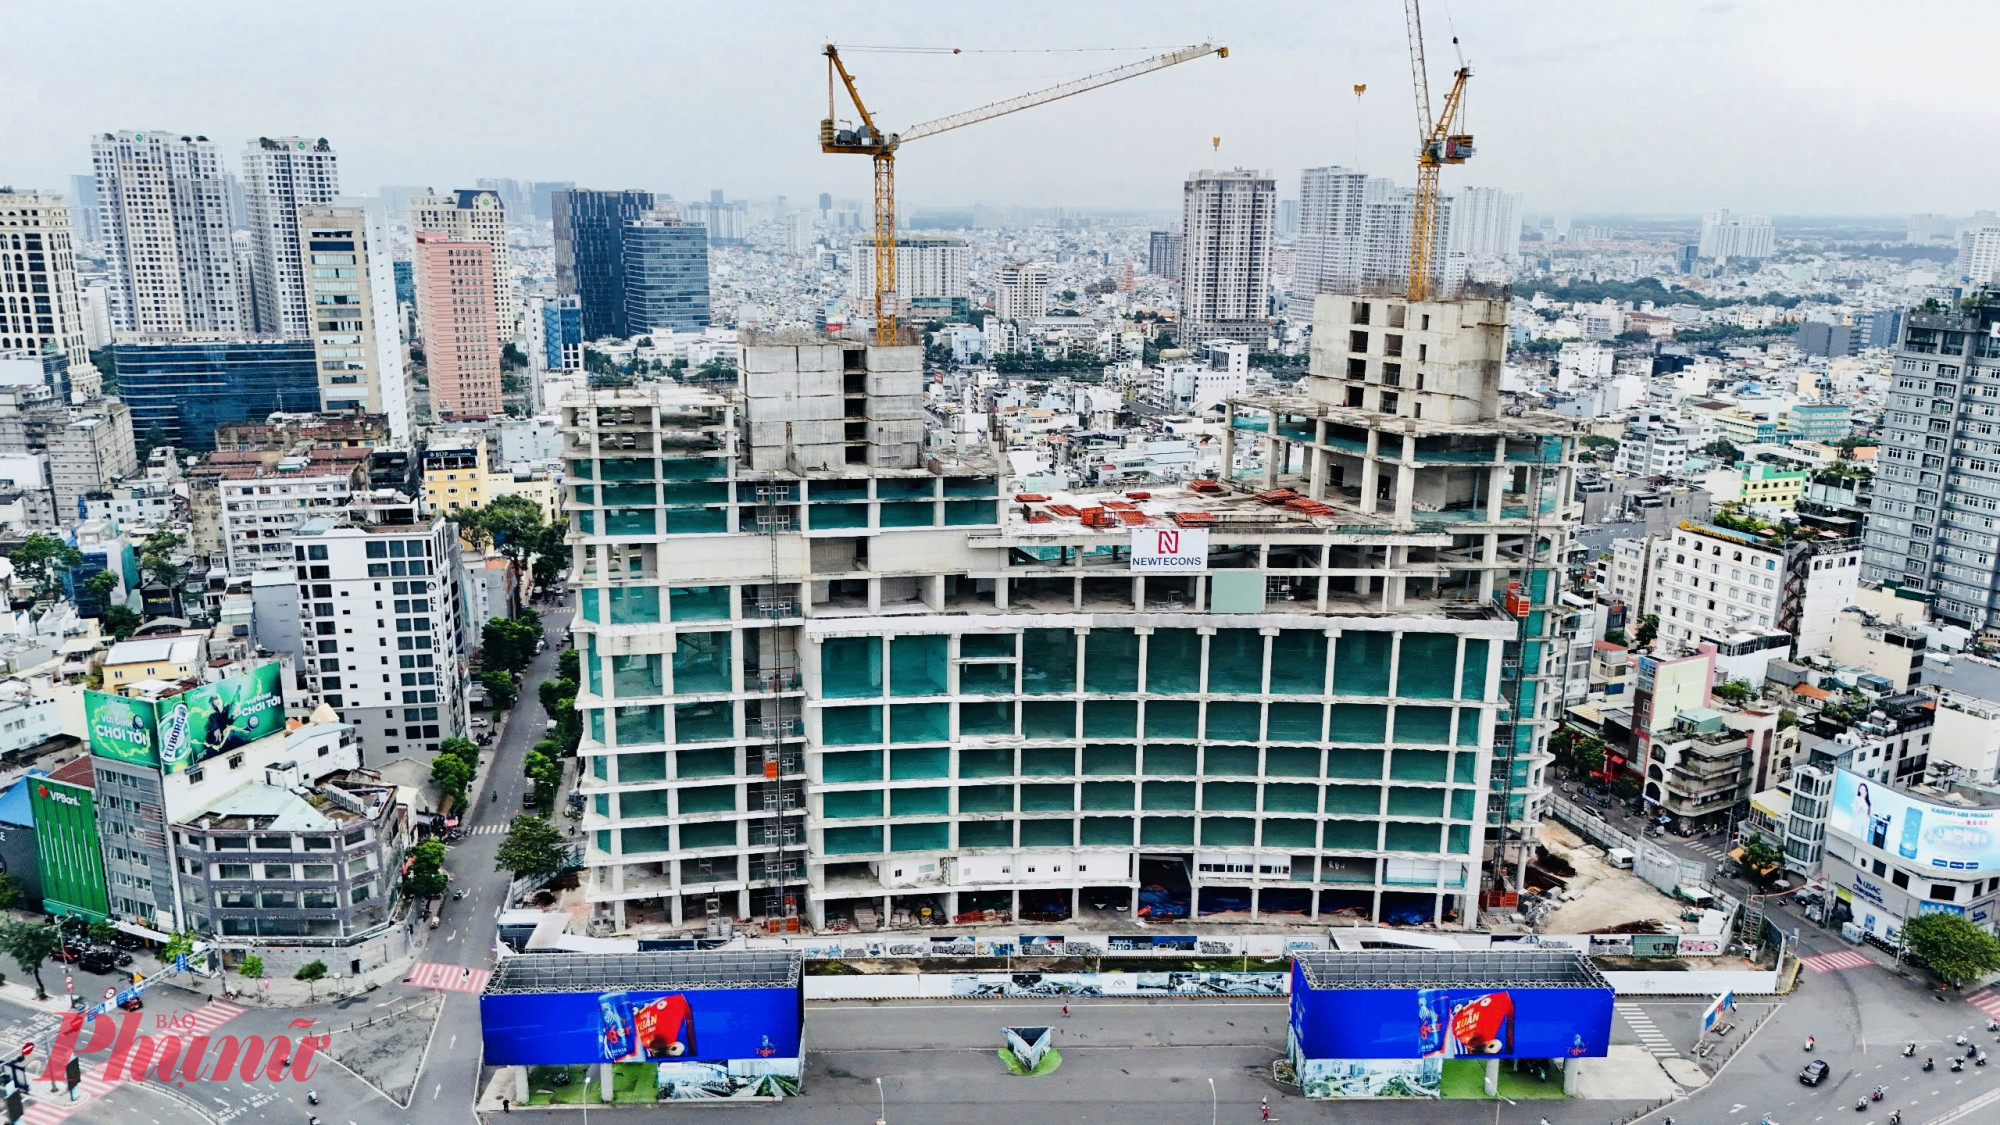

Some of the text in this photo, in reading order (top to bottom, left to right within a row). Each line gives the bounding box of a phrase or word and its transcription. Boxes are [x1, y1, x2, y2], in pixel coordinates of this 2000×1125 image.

[1132, 556, 1202, 566] NEWTECONS
[164, 714, 187, 758] TUBORG
[49, 790, 81, 806] VPBank
[755, 1047, 777, 1057] Tiger
[1567, 1046, 1587, 1056] Tiger
